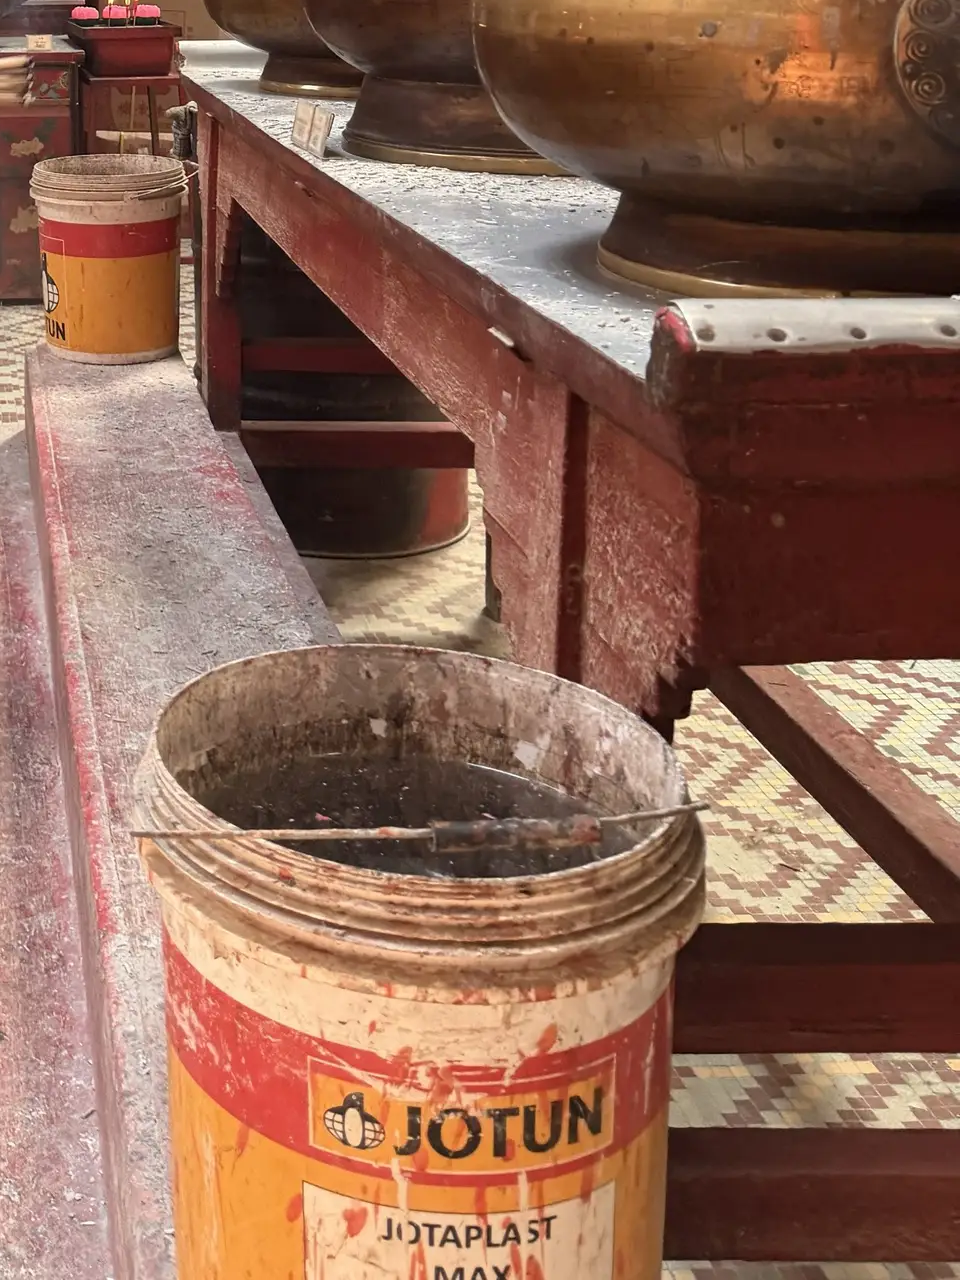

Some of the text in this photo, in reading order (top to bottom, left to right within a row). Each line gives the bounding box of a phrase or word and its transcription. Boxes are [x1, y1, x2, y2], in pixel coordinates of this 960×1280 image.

[394, 1086, 603, 1160] JOTUN
[382, 1215, 557, 1249] JOTAPLAST
[434, 1265, 511, 1280] MAX
